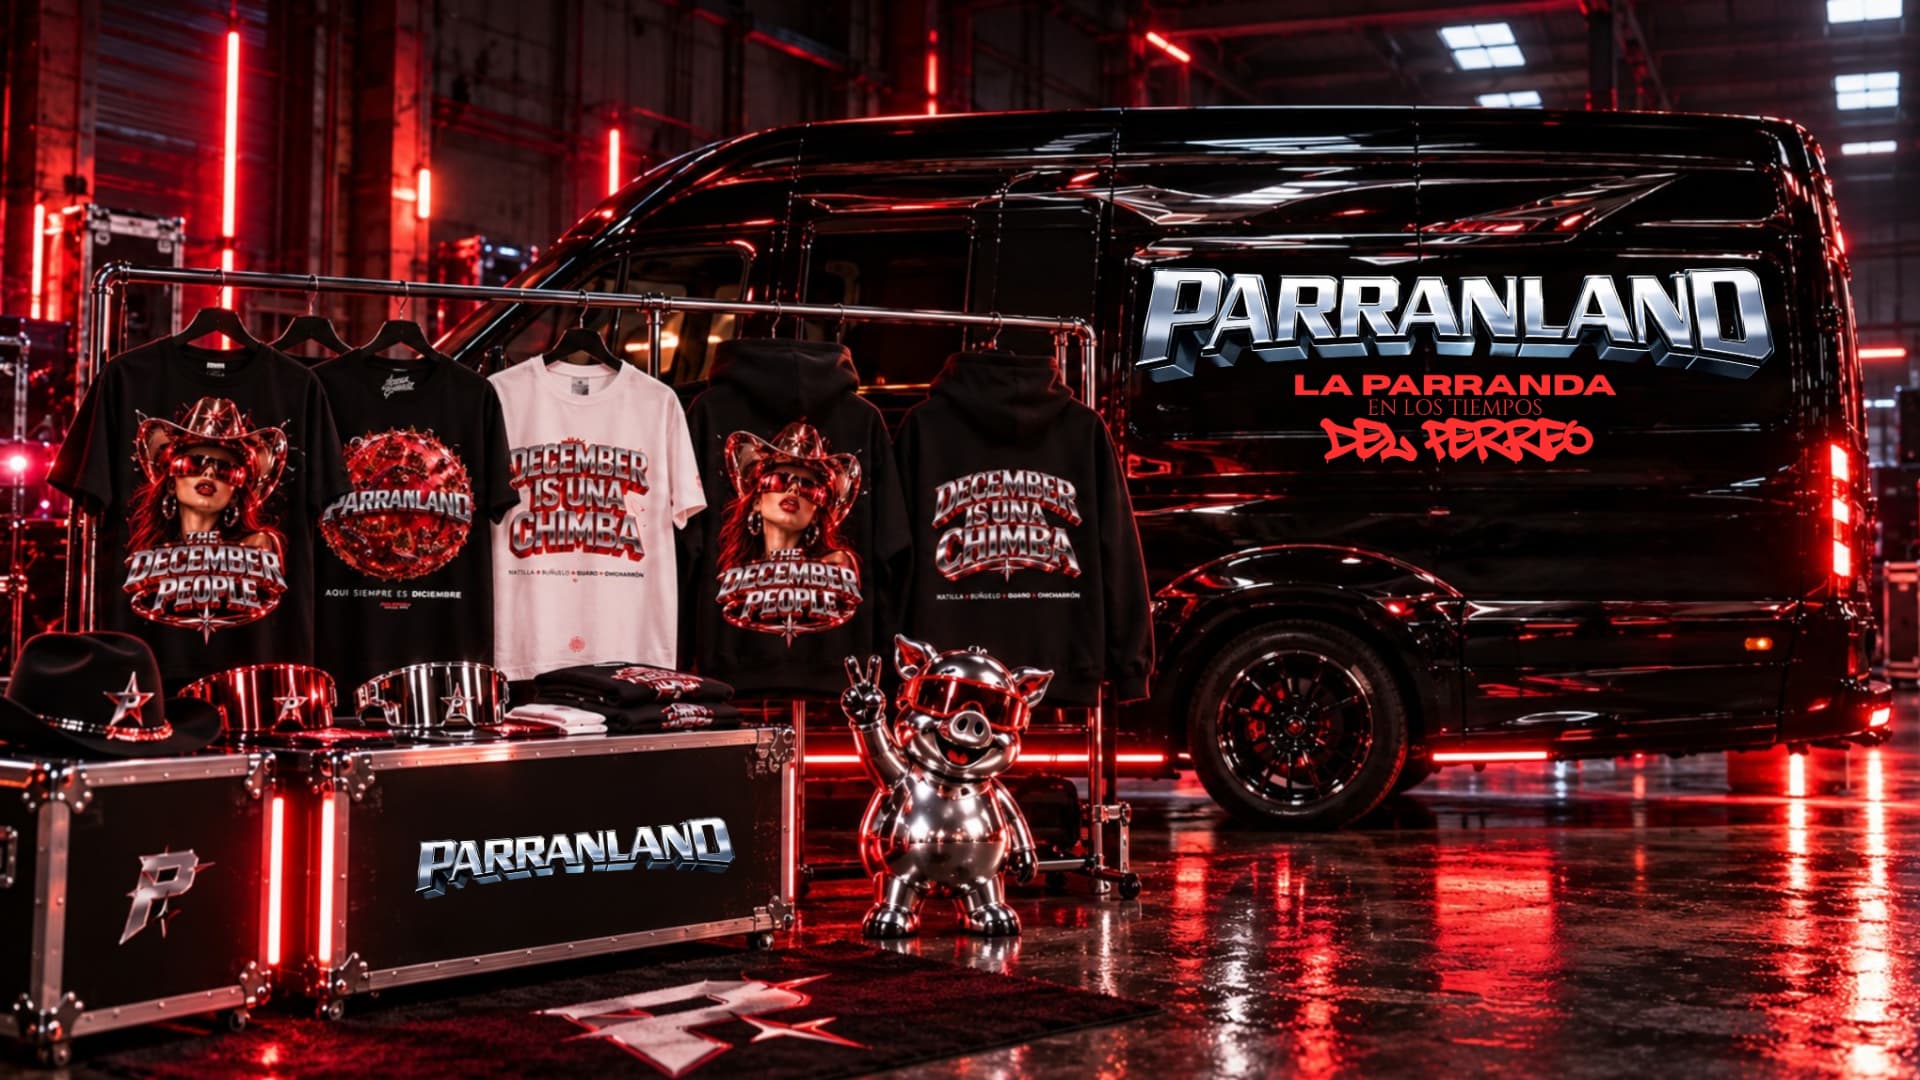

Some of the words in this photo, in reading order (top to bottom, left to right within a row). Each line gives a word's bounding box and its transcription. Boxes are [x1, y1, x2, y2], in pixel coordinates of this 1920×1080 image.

[1136, 267, 1774, 381] PARRANLAND
[1294, 375, 1353, 396] LA
[1362, 375, 1617, 396] PARRANDA
[1368, 399, 1404, 416] EN
[1411, 399, 1447, 416] LOS
[1451, 398, 1543, 417] TIEMPOS
[1320, 418, 1417, 463] DEL
[1423, 419, 1594, 464] PERREO
[510, 443, 650, 496] DECEMBER
[531, 477, 559, 511] IS
[564, 478, 627, 512] UNA
[932, 469, 1083, 527] DECEMBER
[964, 502, 990, 525] IS
[995, 502, 1048, 525] UNA
[186, 531, 220, 545] THE
[509, 510, 645, 561] CHIMBA
[935, 524, 1081, 580] CHIMBA
[124, 548, 287, 592] DECEMBER
[770, 549, 801, 561] THE
[154, 575, 264, 611] PEOPLE
[325, 589, 349, 597] AQUI
[353, 589, 393, 598] SIEMPRE
[411, 590, 462, 599] DICIEMBRE
[717, 562, 863, 602] DECEMBER
[740, 589, 840, 618] PEOPLE
[416, 817, 735, 898] PARRANLAND
